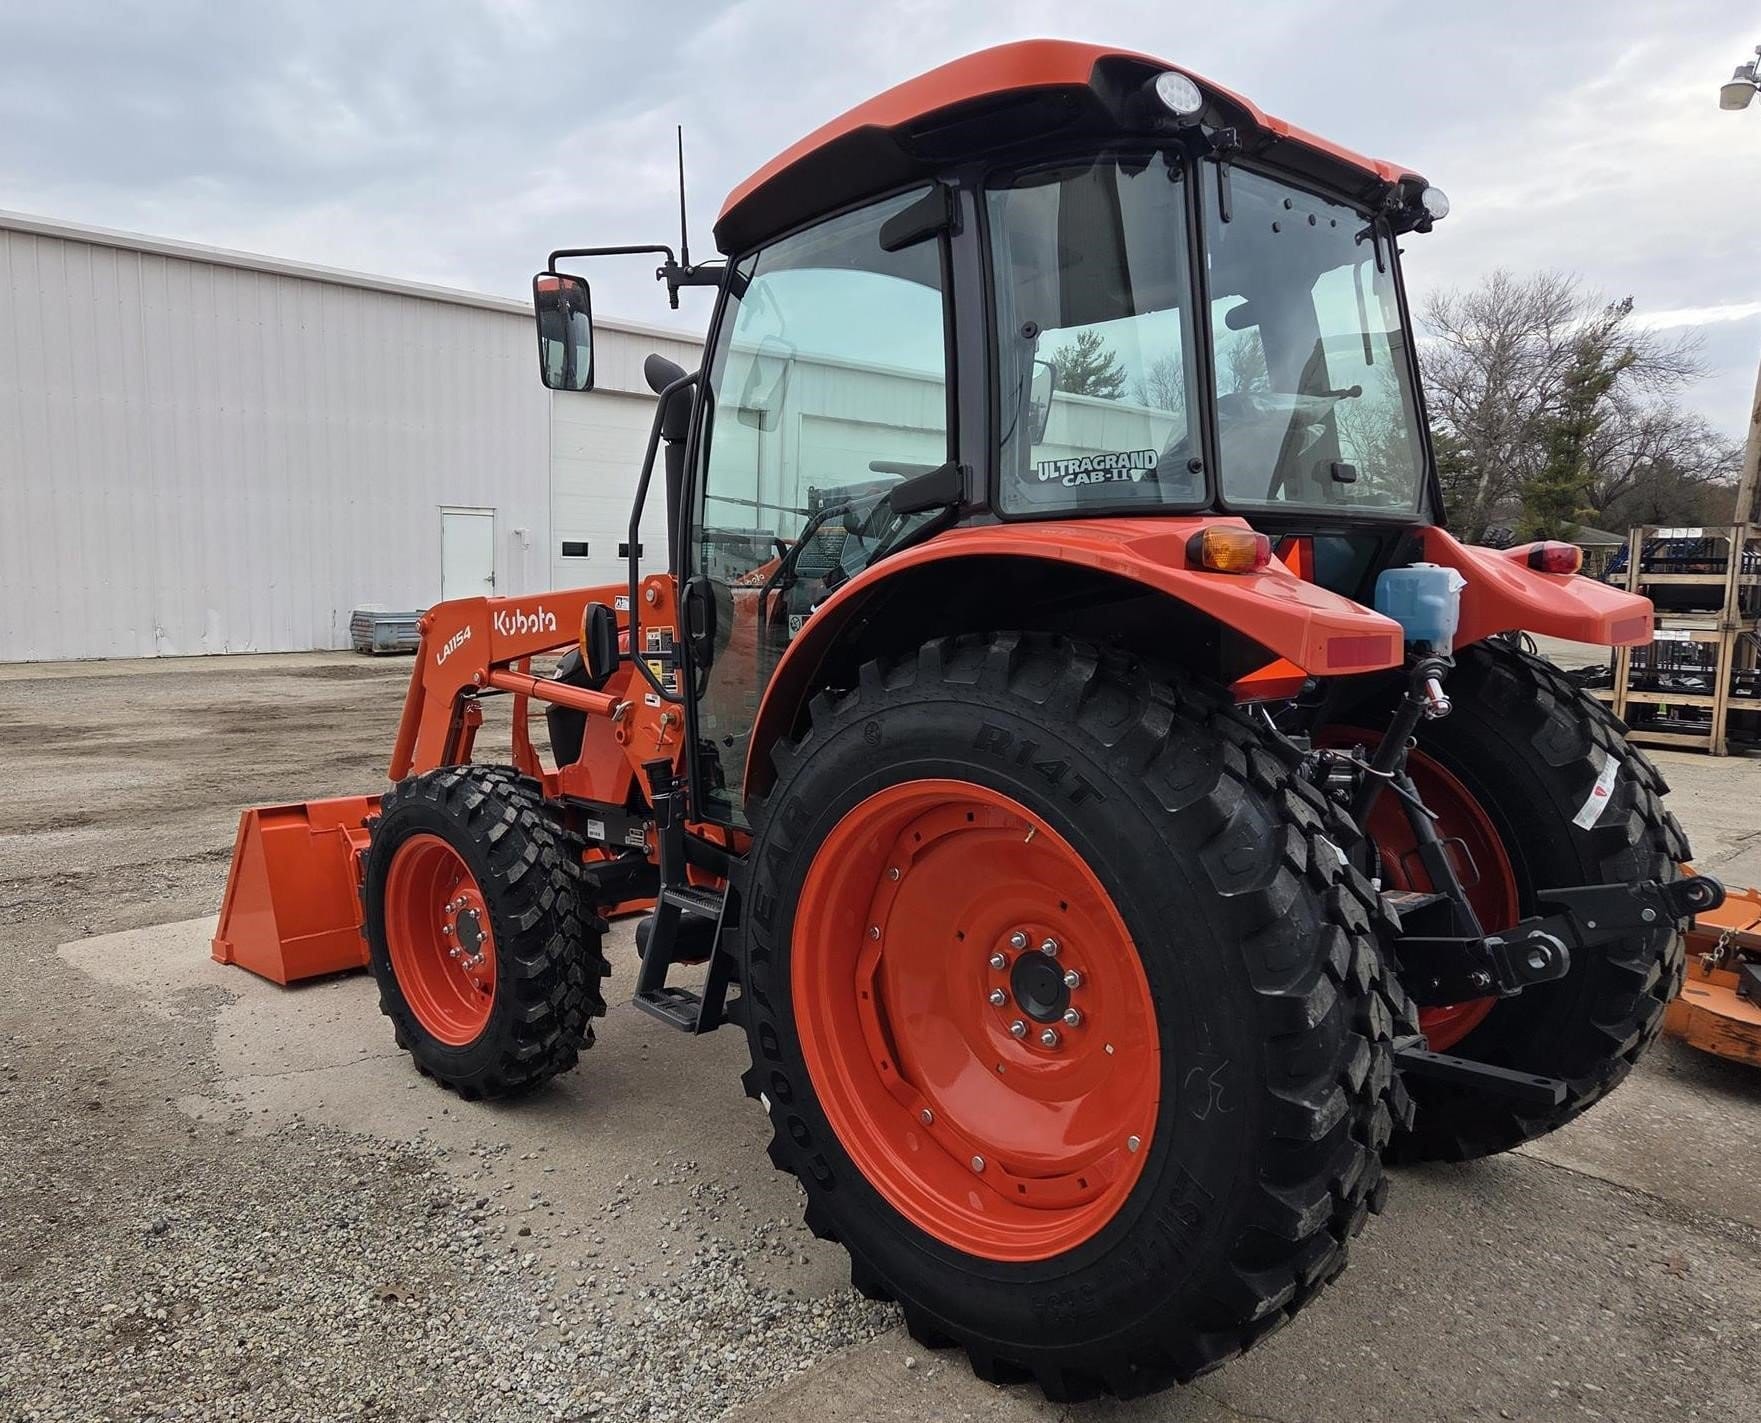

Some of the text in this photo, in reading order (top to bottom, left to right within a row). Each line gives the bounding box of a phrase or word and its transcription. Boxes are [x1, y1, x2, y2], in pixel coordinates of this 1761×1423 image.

[1038, 449, 1159, 482] ULTRAGRAND
[493, 605, 556, 637] Kubota
[435, 625, 472, 666] LA1154
[972, 721, 1107, 807] R14T
